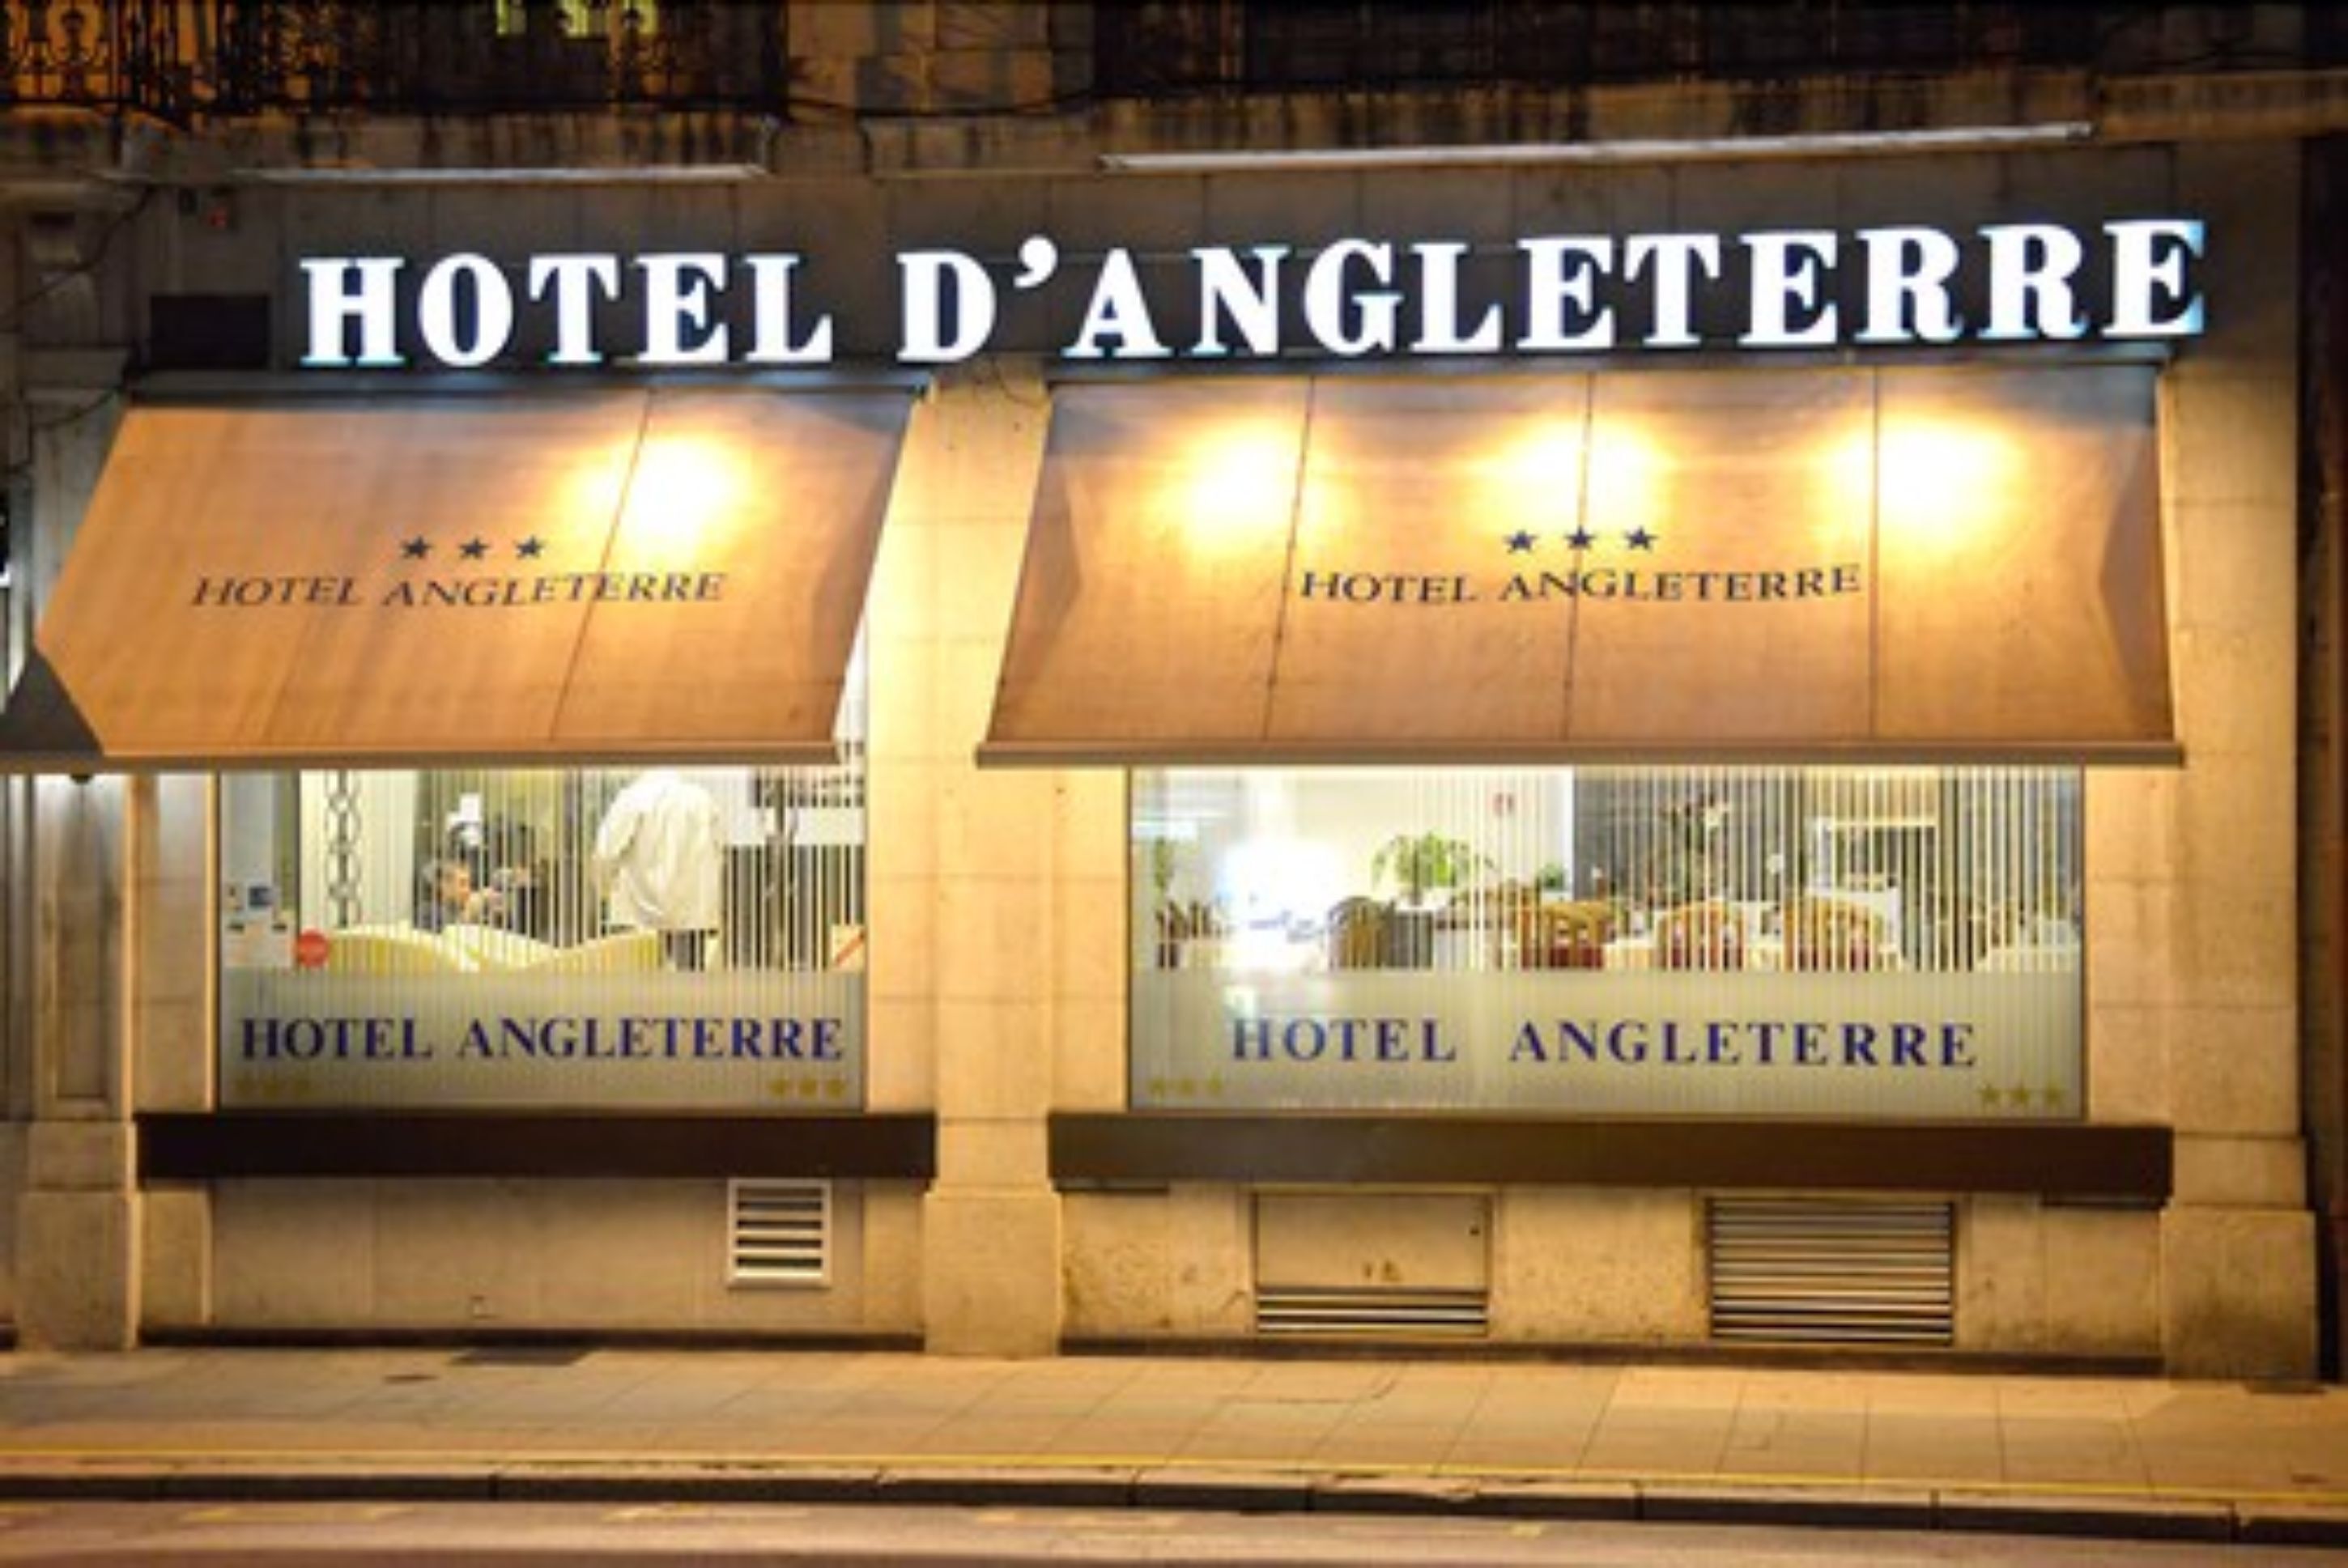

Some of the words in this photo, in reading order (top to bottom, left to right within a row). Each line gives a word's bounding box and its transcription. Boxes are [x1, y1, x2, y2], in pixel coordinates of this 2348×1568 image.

[300, 253, 832, 366] HOTEL
[190, 576, 364, 607] HOTEL
[381, 572, 726, 607] ANGLETERRE
[1299, 570, 1478, 605] HOTEL
[1499, 563, 1862, 601] ANGLETERRE
[240, 1018, 433, 1060] HOTEL
[457, 1018, 844, 1060] ANGLETERRE
[1230, 1018, 1457, 1062] HOTEL
[1508, 1019, 1976, 1067] ANGLETERRE
